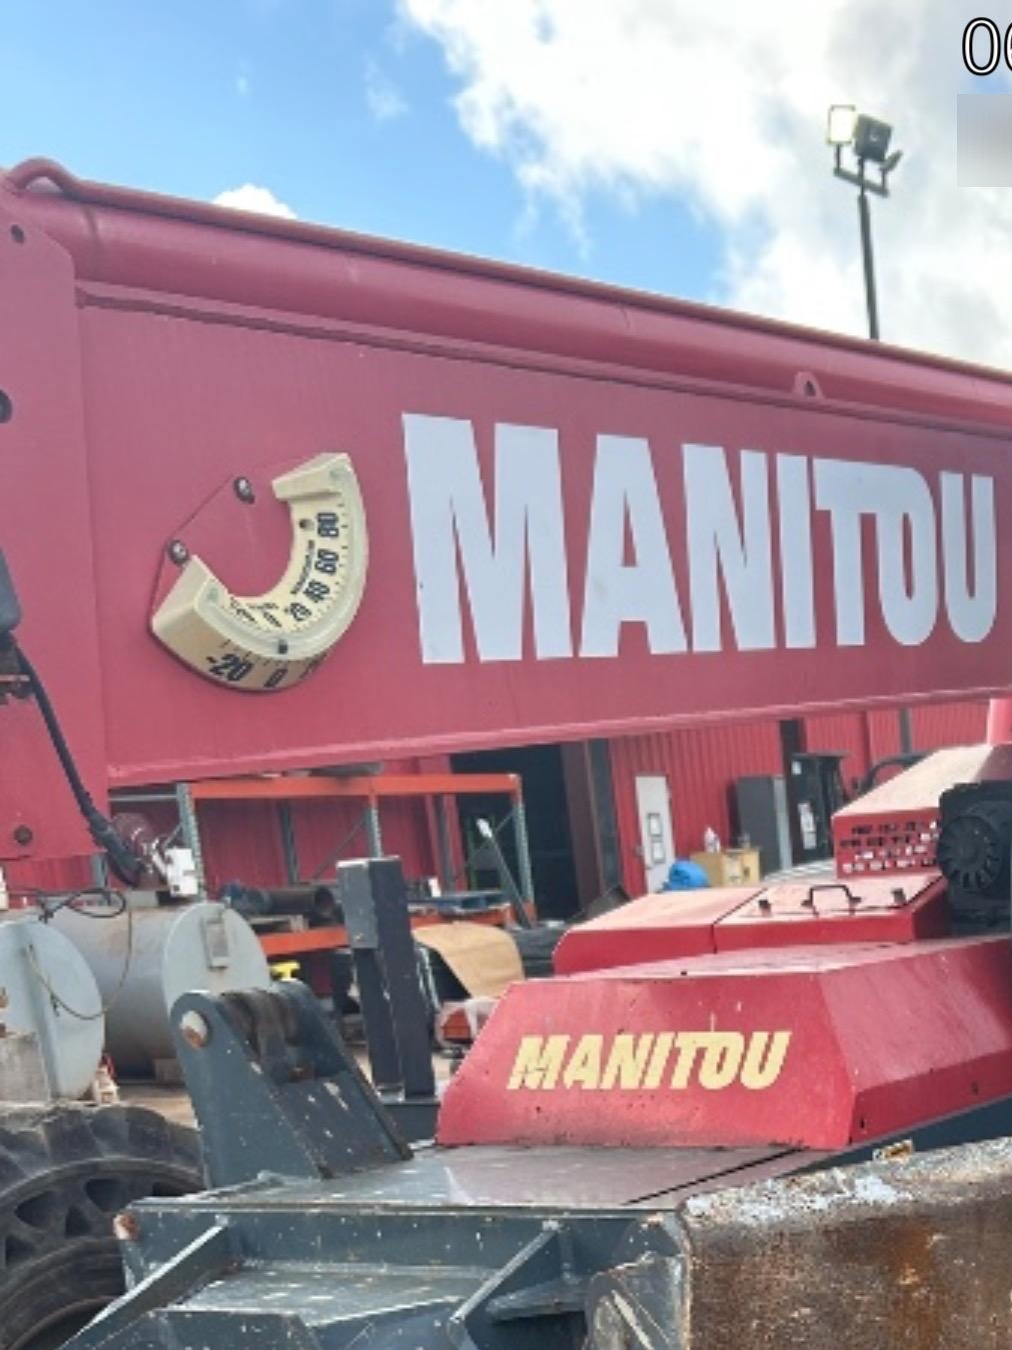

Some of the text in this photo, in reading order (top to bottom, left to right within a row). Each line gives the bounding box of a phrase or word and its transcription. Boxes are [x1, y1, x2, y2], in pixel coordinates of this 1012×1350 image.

[317, 512, 339, 538] 80
[402, 412, 997, 664] MANITOU
[315, 549, 339, 574] 60
[206, 653, 252, 682] -20
[506, 1031, 792, 1091] MANITOU
